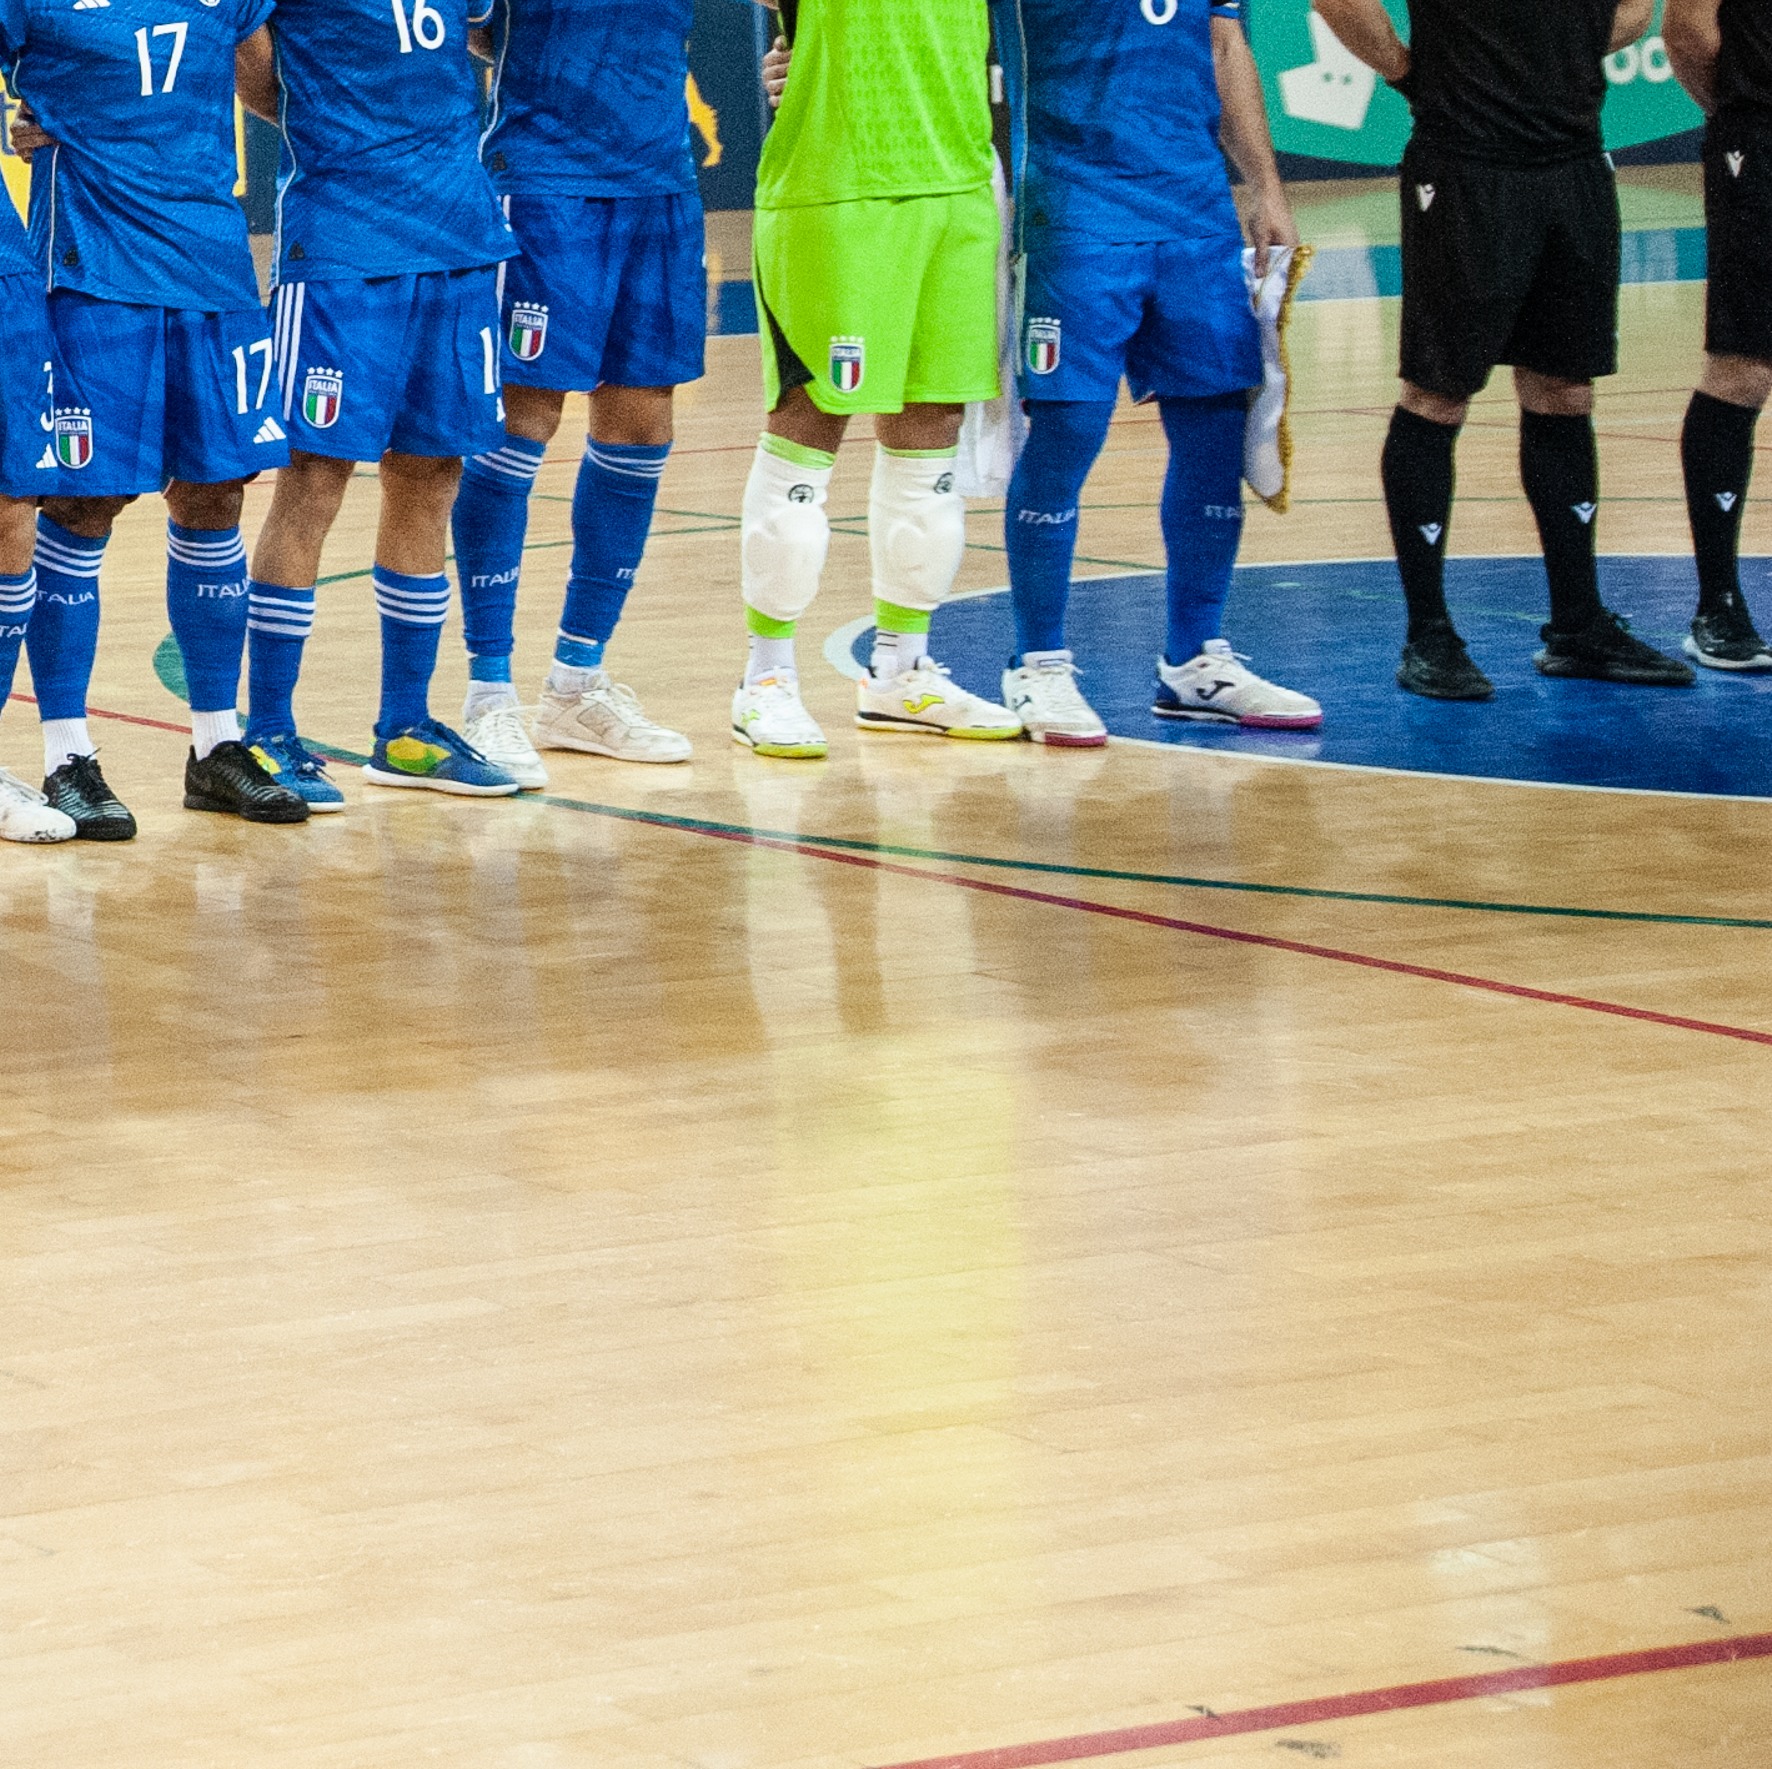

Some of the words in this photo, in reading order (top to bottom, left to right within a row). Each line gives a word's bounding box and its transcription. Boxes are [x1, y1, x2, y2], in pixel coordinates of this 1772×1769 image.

[134, 22, 188, 97] 17
[232, 338, 274, 415] 17
[306, 379, 340, 394] ITALIA
[57, 416, 92, 431] ITALIA
